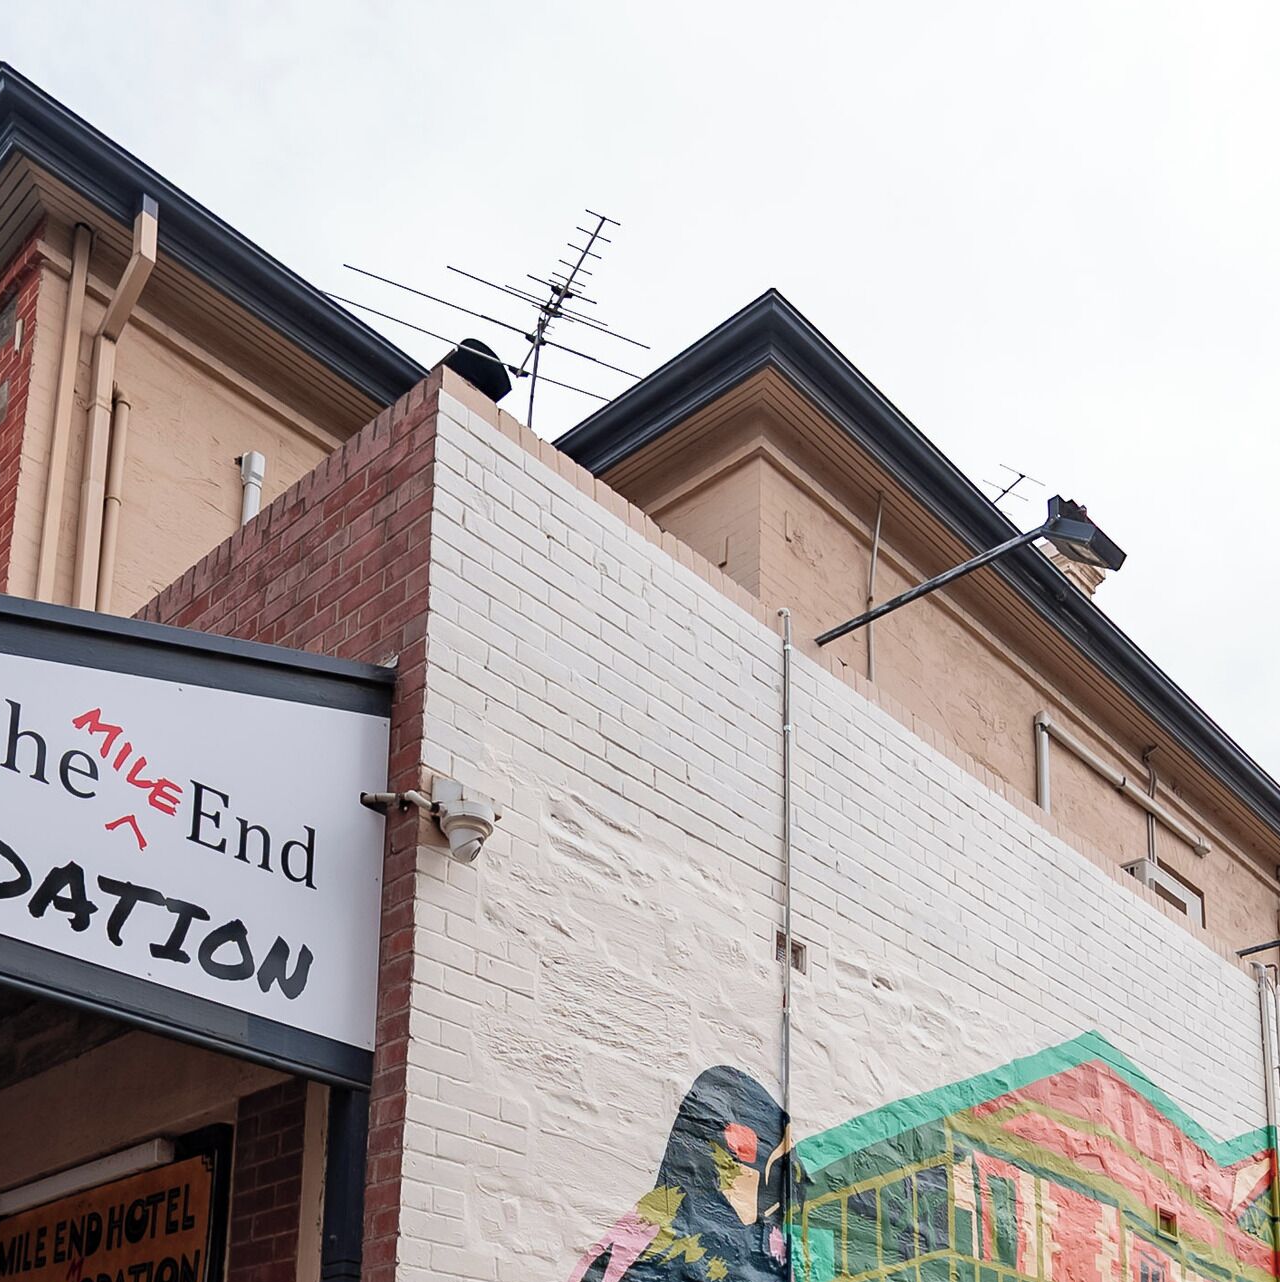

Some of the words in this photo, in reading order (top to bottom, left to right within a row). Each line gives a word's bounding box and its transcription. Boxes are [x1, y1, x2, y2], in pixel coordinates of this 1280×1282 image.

[73, 708, 183, 815] MILE
[186, 779, 318, 890] End
[53, 1212, 103, 1264] END
[106, 1184, 196, 1251] HOTEL
